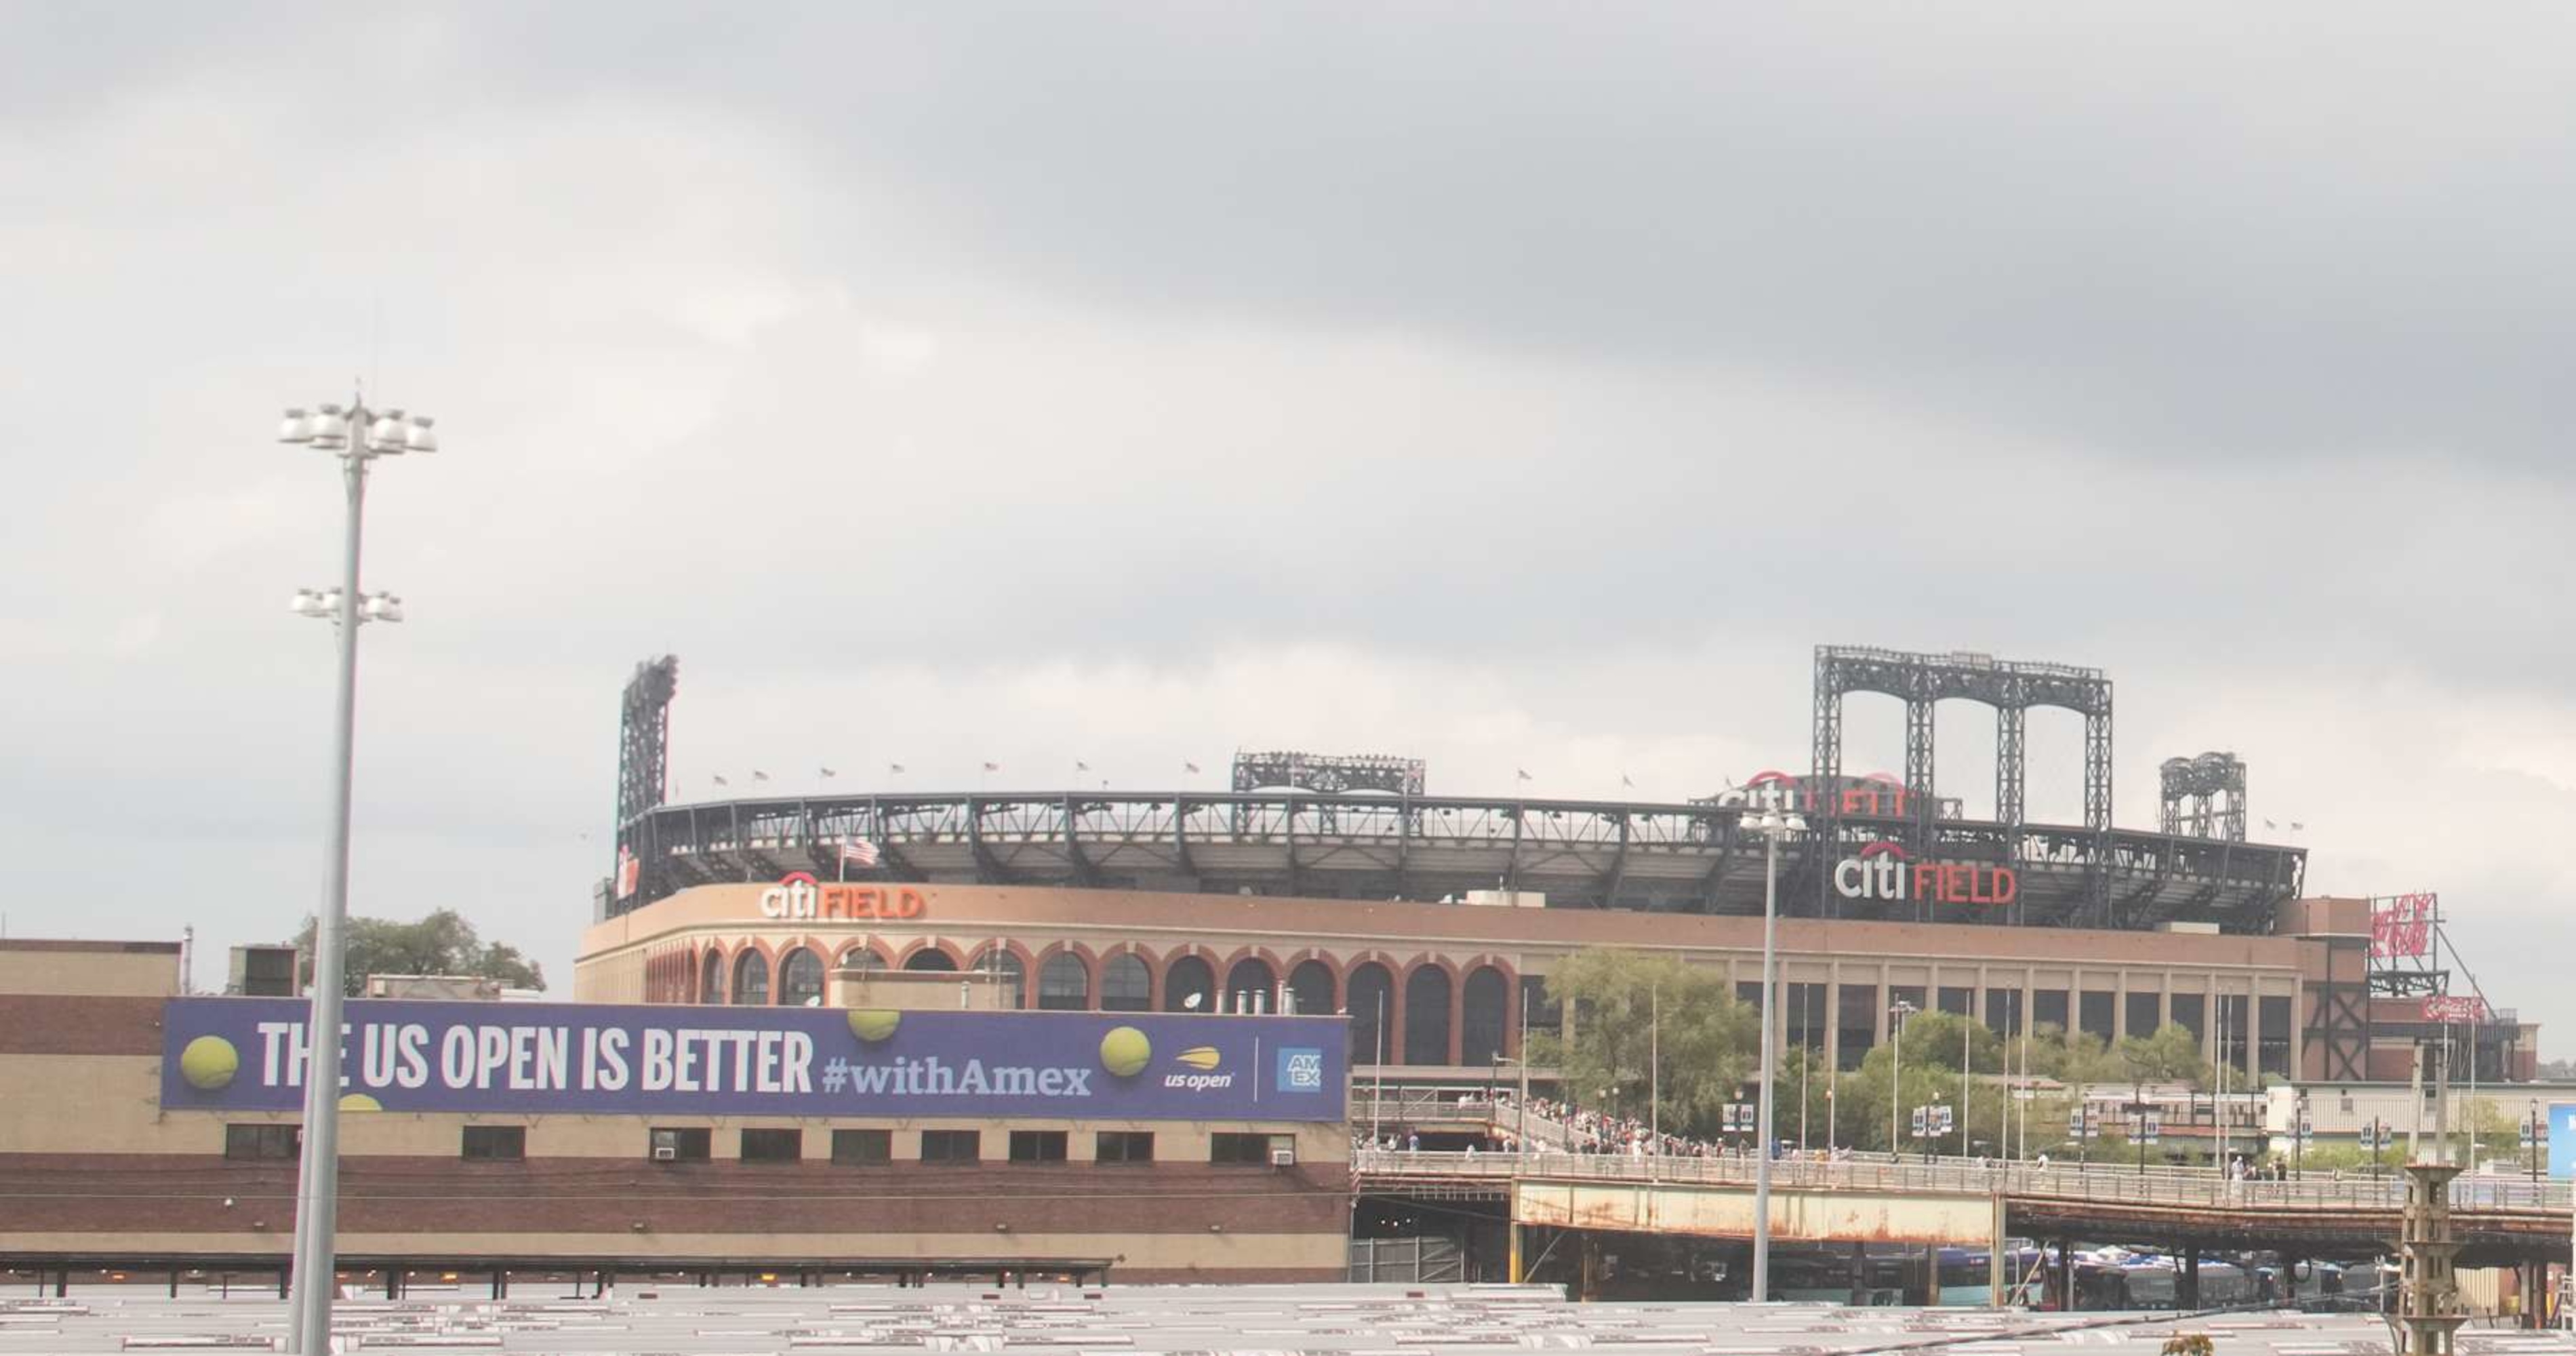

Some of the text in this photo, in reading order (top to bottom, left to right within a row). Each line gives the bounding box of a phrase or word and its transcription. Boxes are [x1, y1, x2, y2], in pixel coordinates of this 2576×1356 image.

[759, 880, 926, 919] citi FIELD
[1834, 850, 2016, 904] citi FIELD
[363, 1023, 430, 1089] US
[441, 1024, 569, 1090] OPEN
[582, 1027, 630, 1091] IS
[641, 1029, 813, 1093] BETTER
[822, 1056, 1092, 1096] #withAmex
[1165, 1074, 1232, 1092] us open
